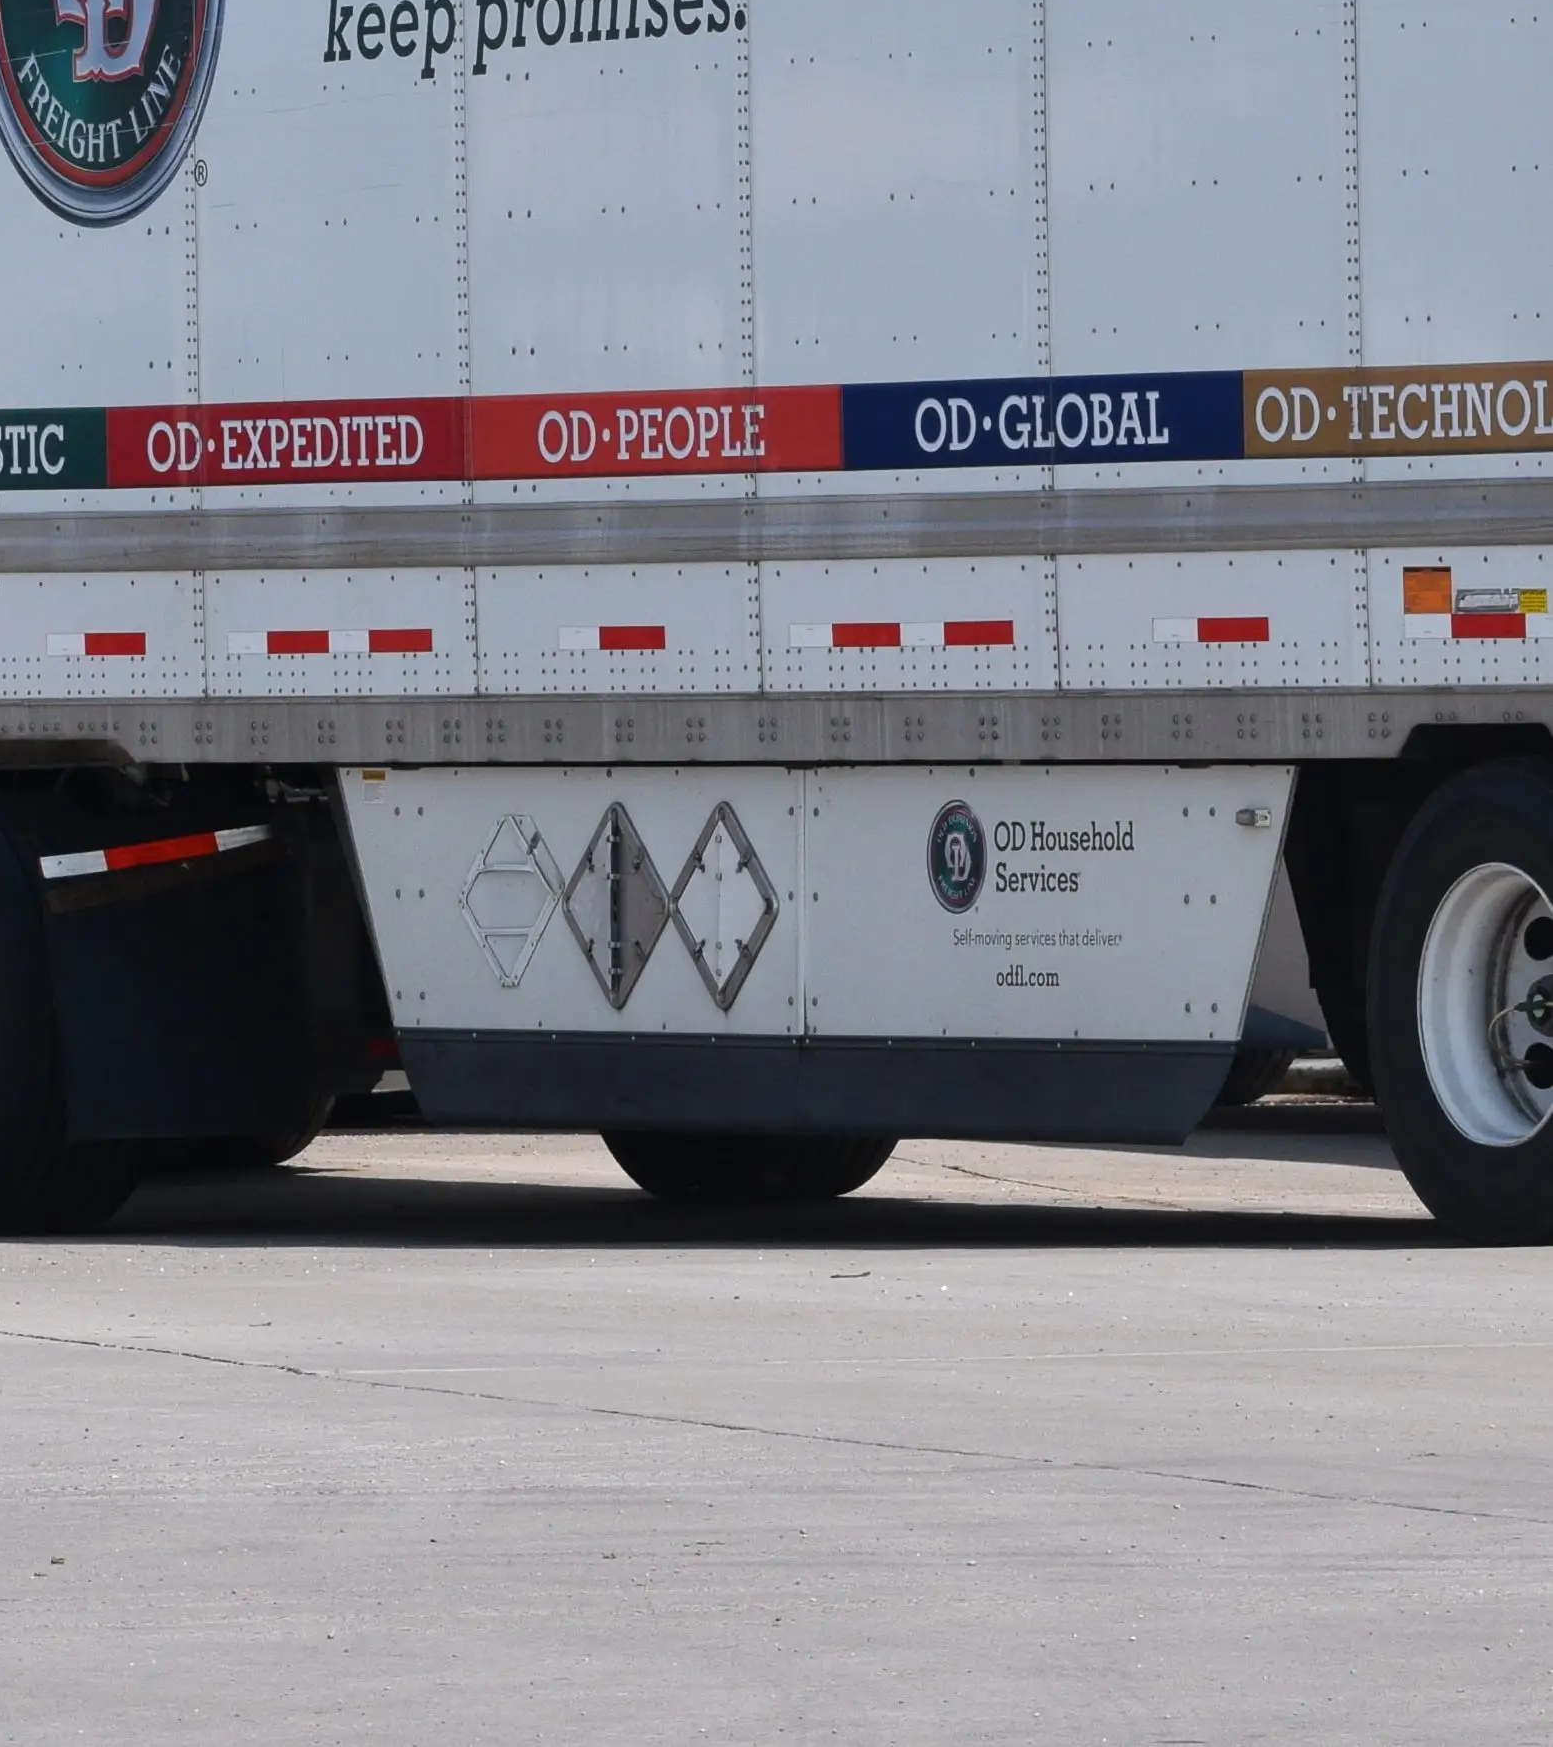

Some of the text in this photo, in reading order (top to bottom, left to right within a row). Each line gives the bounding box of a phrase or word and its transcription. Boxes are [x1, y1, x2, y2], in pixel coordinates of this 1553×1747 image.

[16, 43, 183, 163] FREIGHT LINE
[994, 821, 1026, 852] OD
[1030, 820, 1135, 852] Household
[995, 862, 1080, 893] Services
[953, 928, 1012, 950] Self-moving
[1015, 929, 1056, 947] services
[1058, 927, 1080, 946] that
[995, 964, 1060, 988] odfl.com
